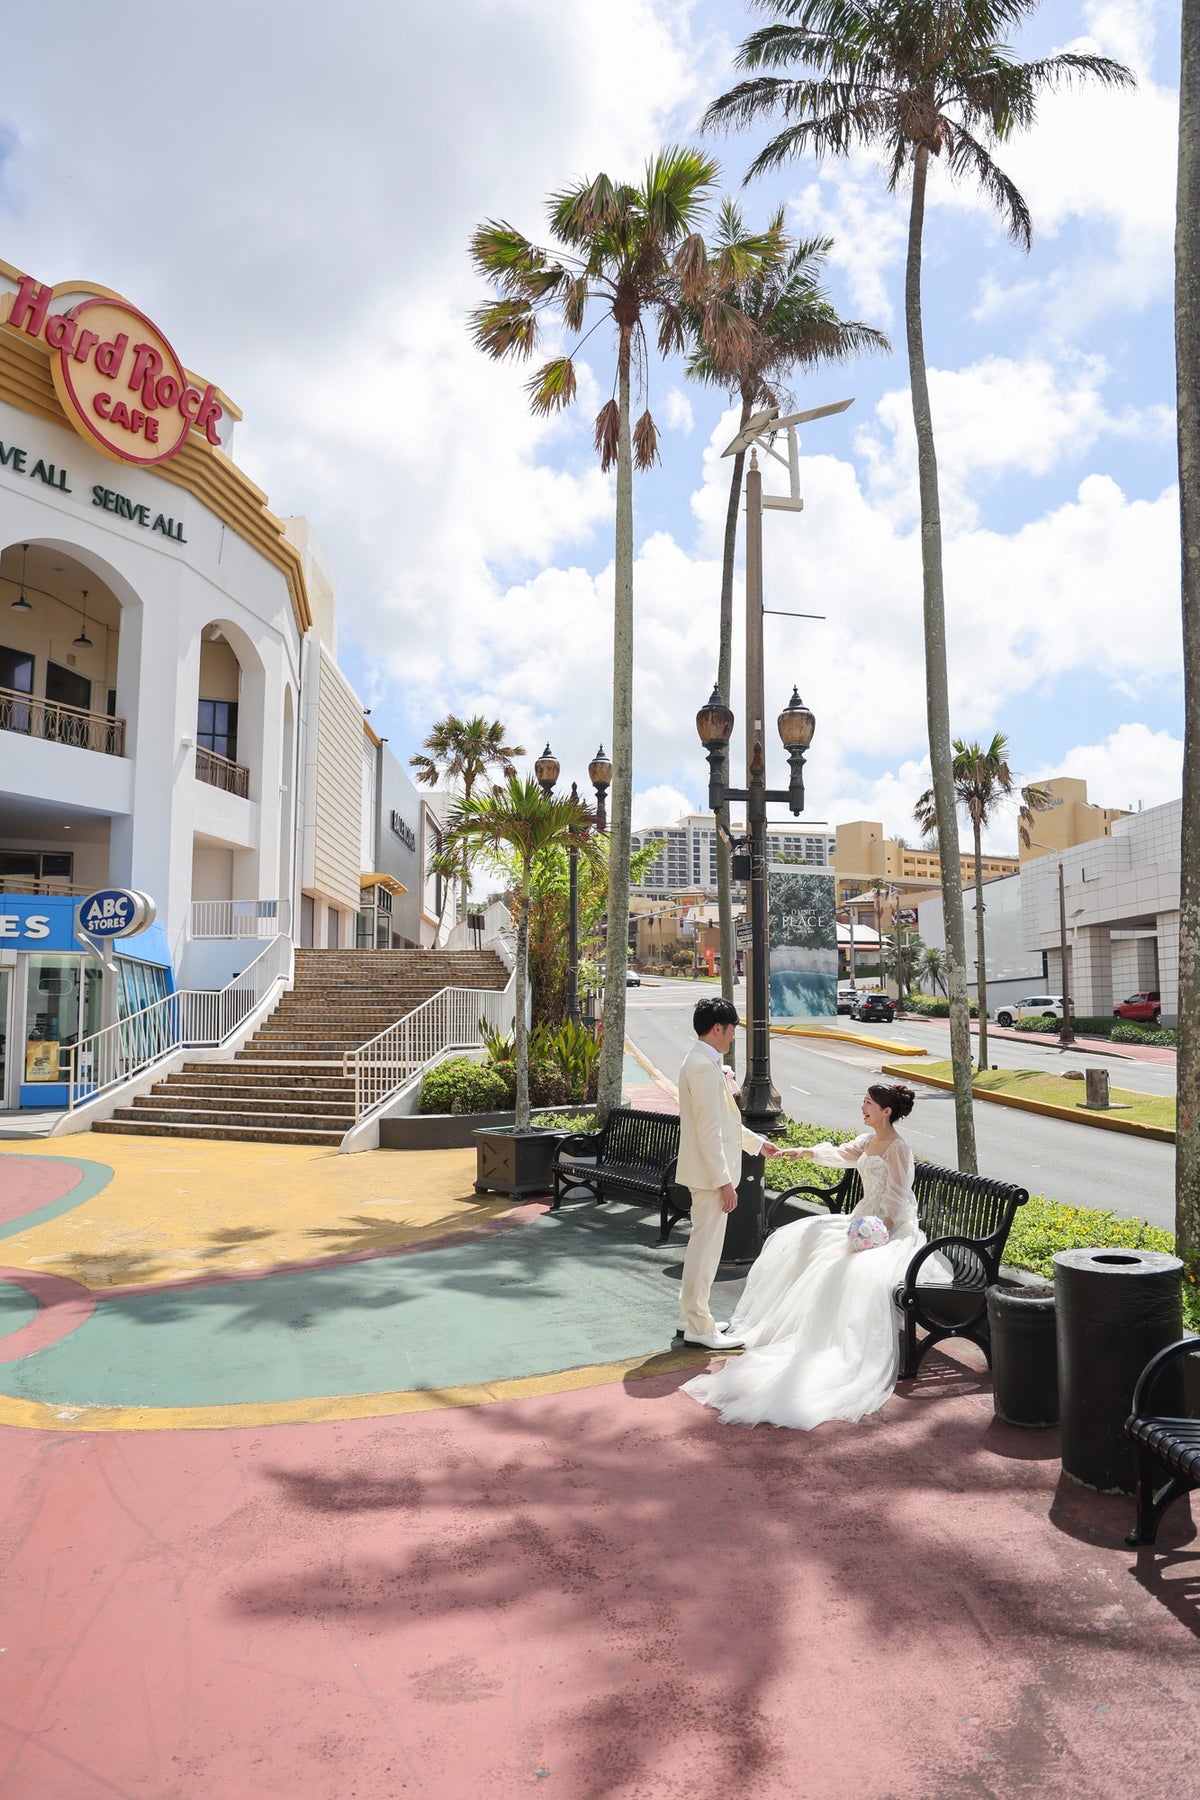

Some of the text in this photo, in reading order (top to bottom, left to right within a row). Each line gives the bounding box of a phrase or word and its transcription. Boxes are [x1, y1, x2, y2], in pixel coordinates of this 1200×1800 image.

[8, 275, 223, 446] Hard Rock
[93, 392, 159, 444] CAFE
[30, 458, 73, 493] ALL
[92, 485, 151, 528] SERVE
[152, 513, 188, 544] ALL
[87, 896, 128, 920] ABC
[0, 914, 51, 939] ES
[88, 917, 126, 931] STORES
[782, 915, 826, 928] PLACE
